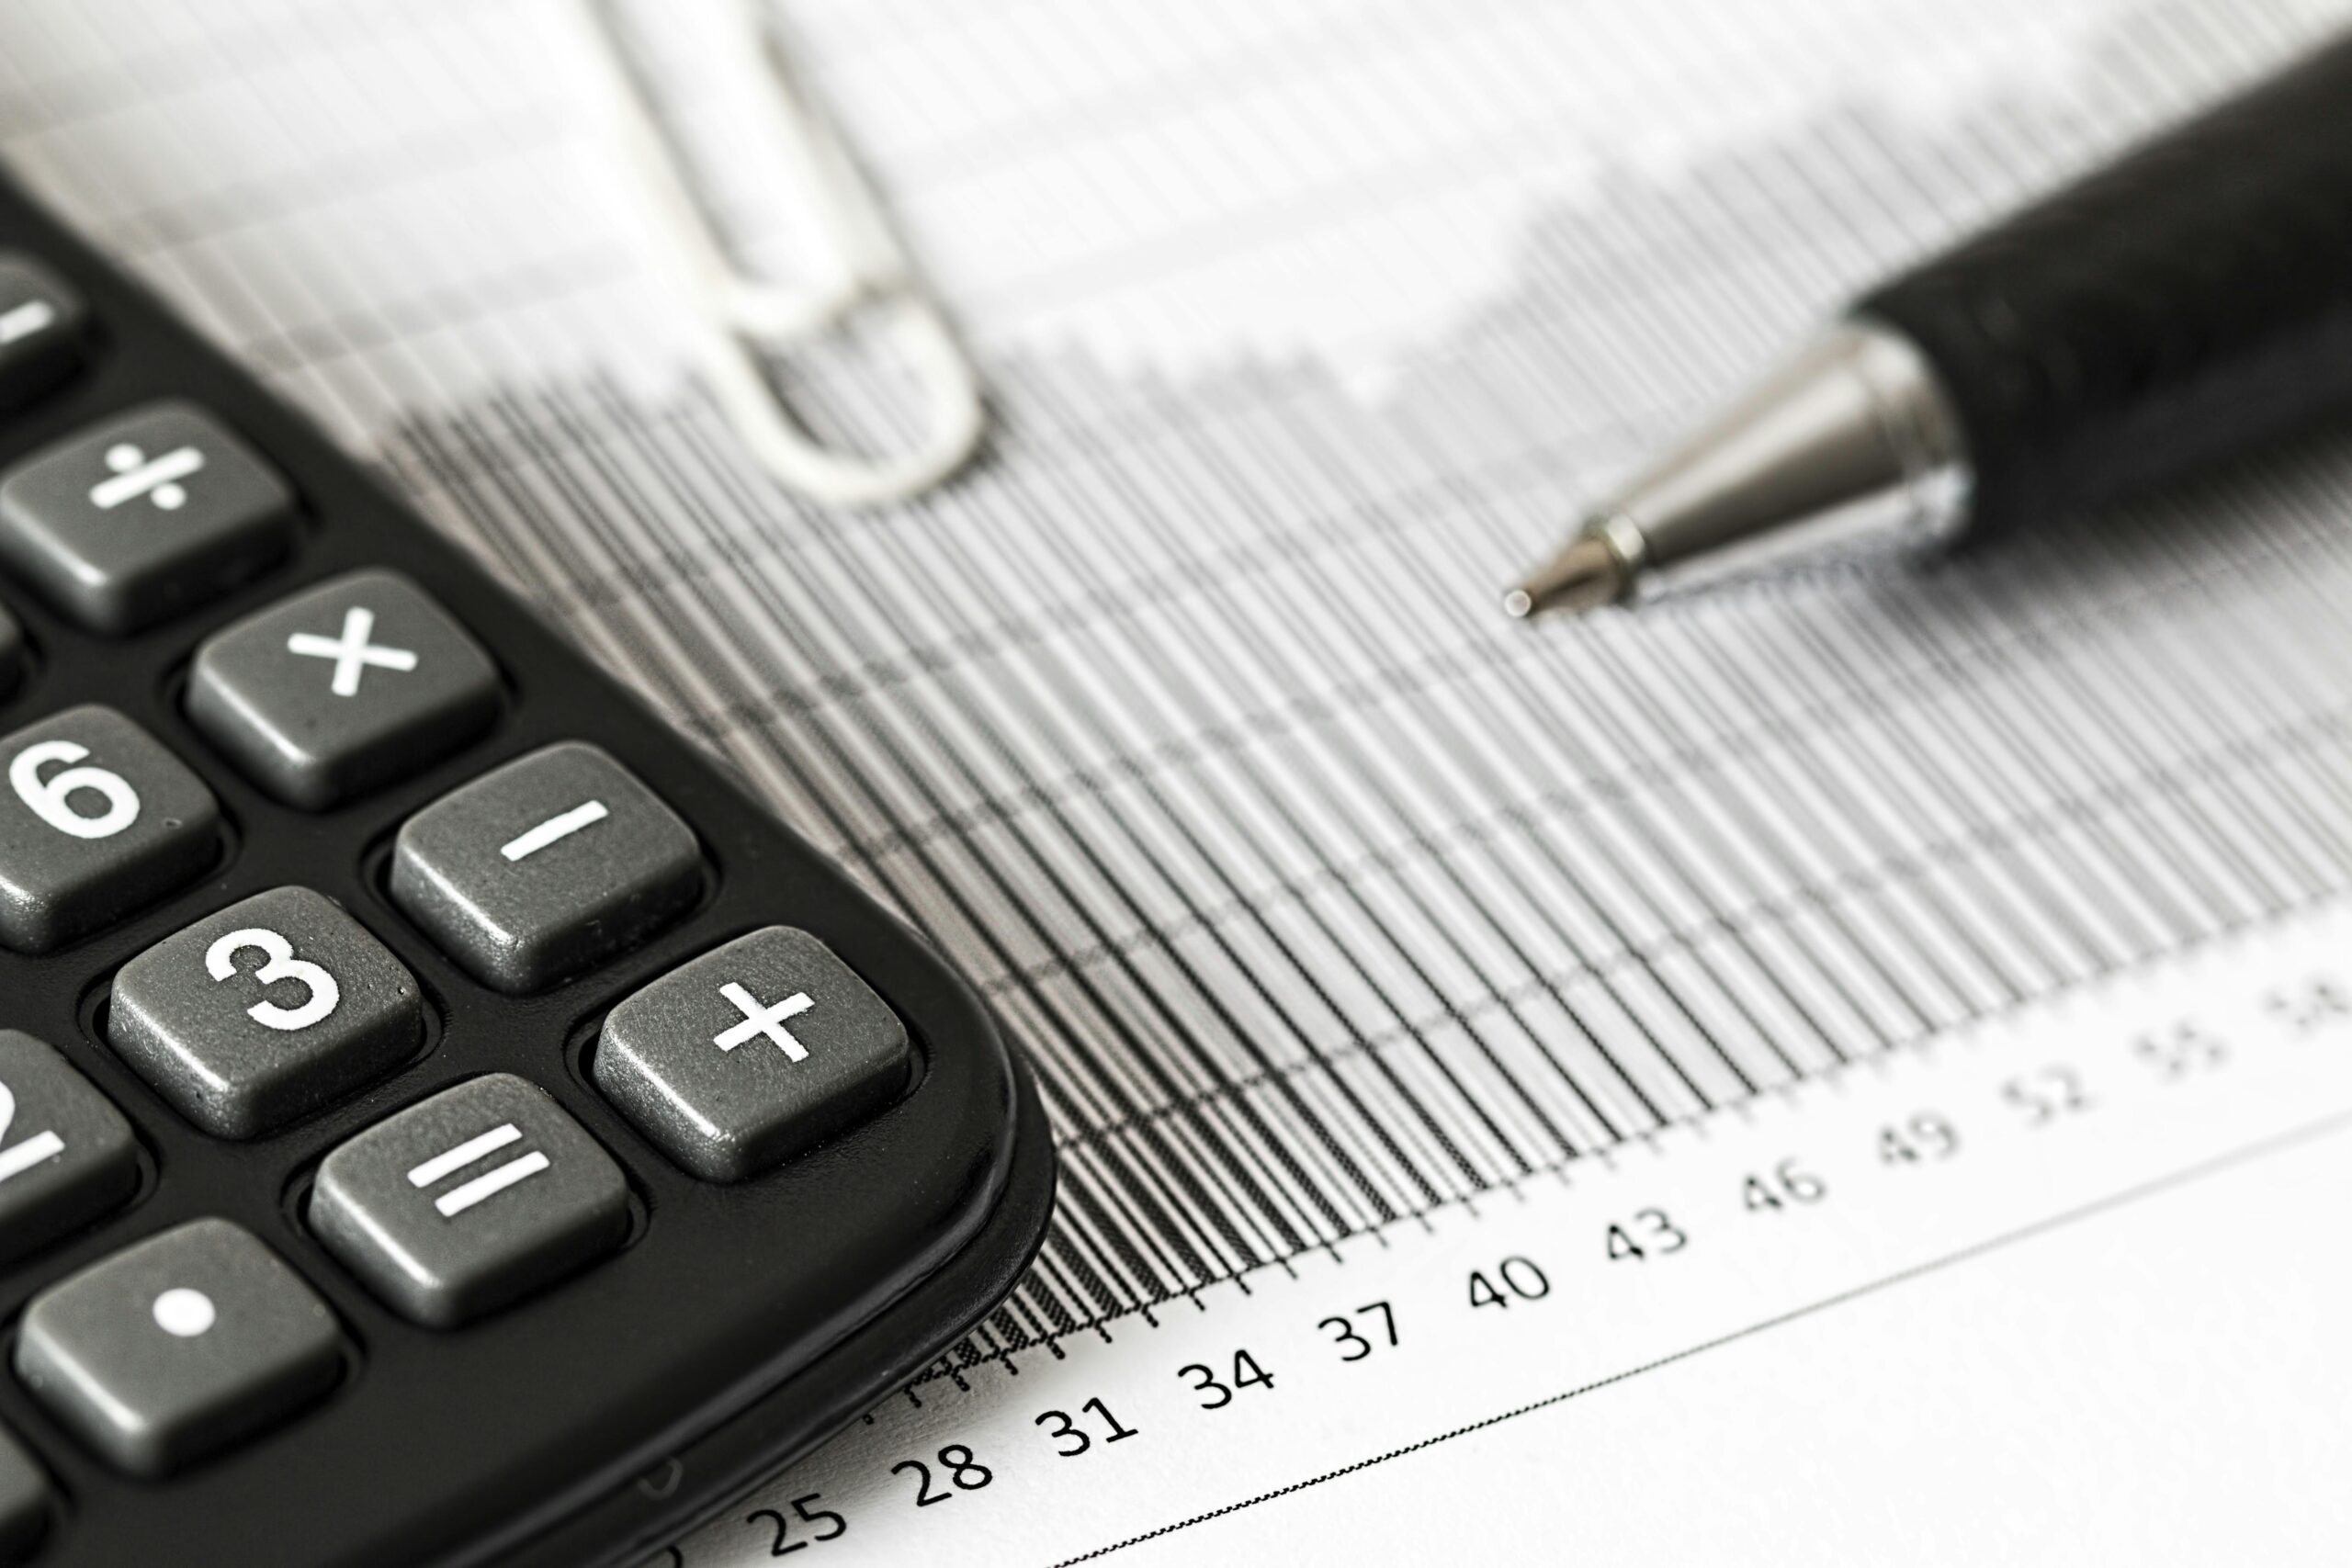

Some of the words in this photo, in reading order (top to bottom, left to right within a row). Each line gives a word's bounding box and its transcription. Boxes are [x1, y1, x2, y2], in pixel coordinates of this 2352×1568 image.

[9, 740, 141, 839] 6
[205, 928, 340, 1031] 3
[745, 1492, 847, 1558] 25
[890, 1444, 994, 1508] 28
[1034, 1396, 1139, 1458] 31
[1176, 1348, 1275, 1410] 34
[1317, 1300, 1400, 1362] 37
[1469, 1255, 1551, 1309] 40
[1607, 1207, 1689, 1263] 43
[1744, 1157, 1826, 1212] 46
[1877, 1111, 1961, 1167] 49
[1998, 1064, 2097, 1128] 52
